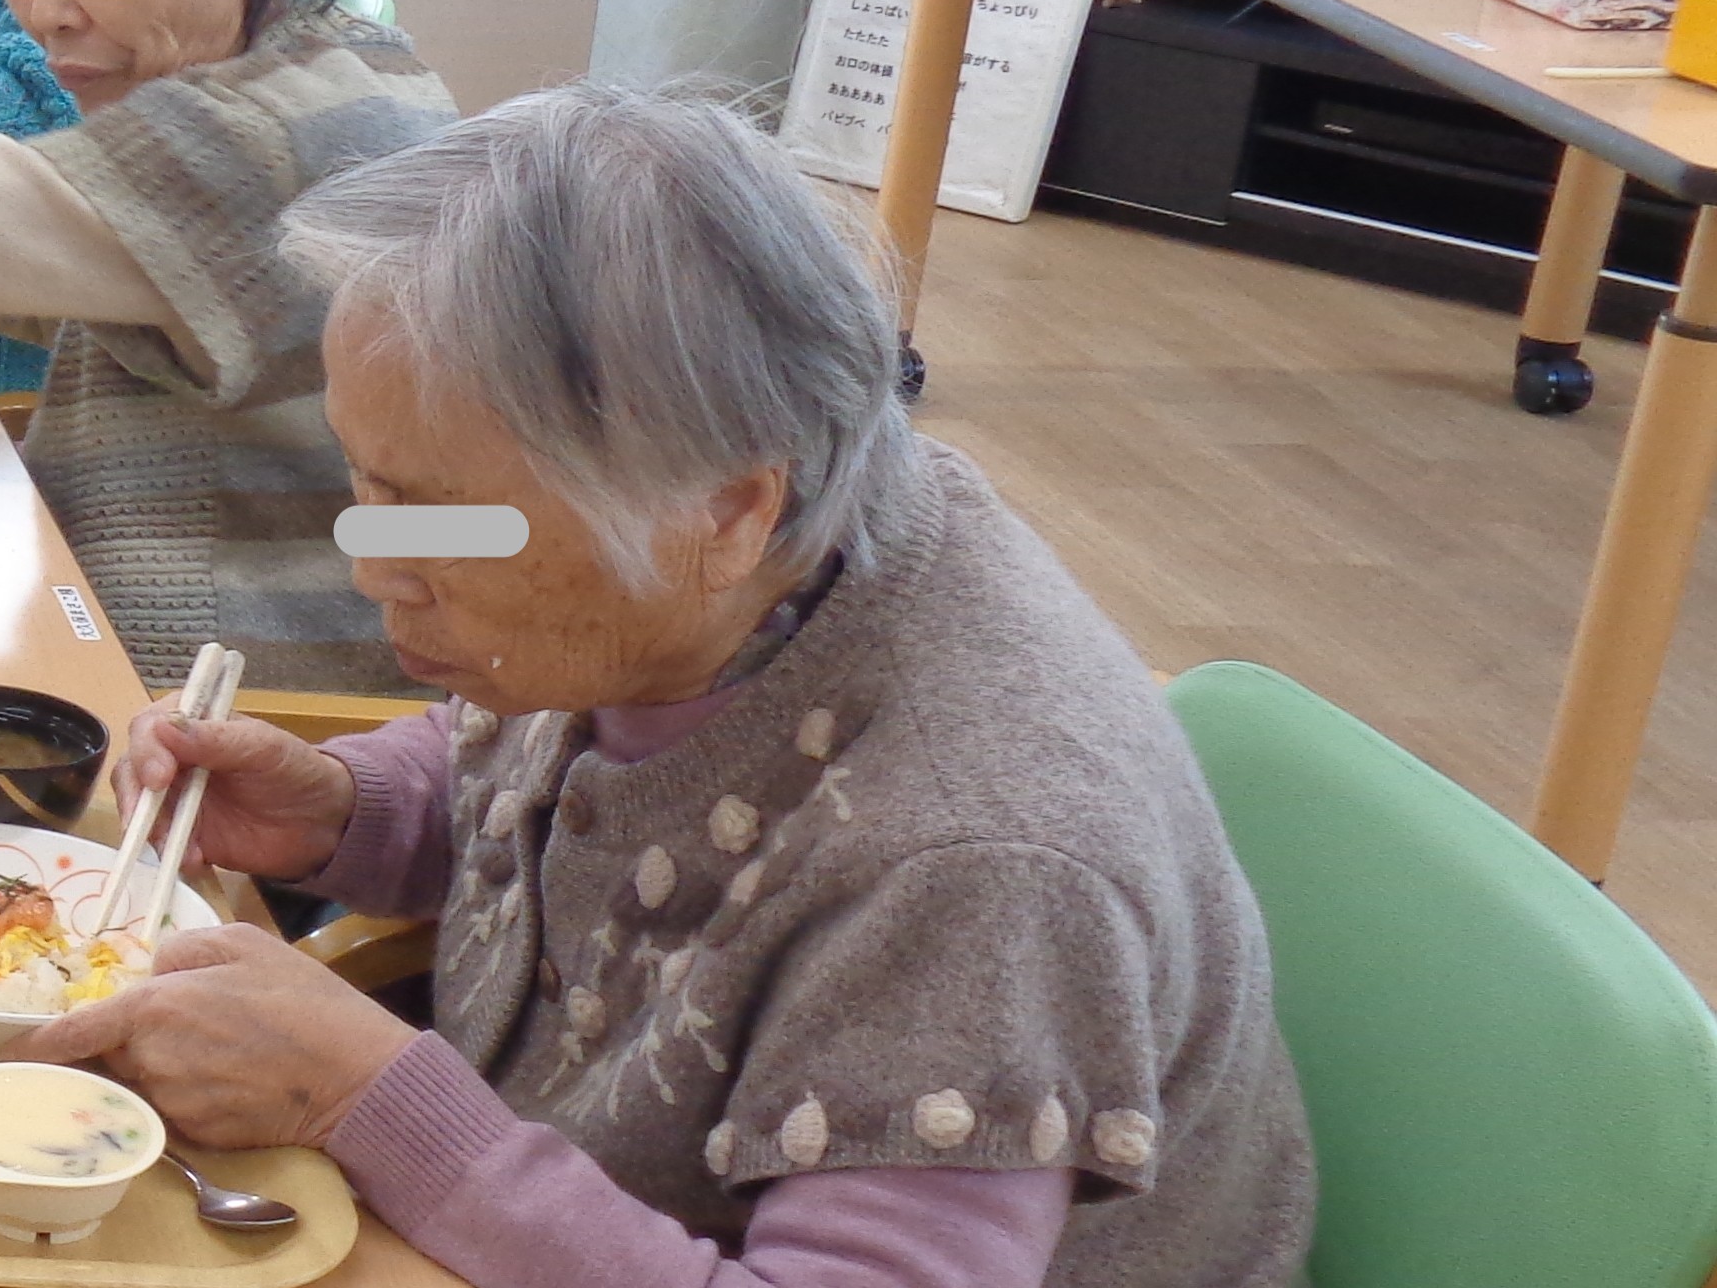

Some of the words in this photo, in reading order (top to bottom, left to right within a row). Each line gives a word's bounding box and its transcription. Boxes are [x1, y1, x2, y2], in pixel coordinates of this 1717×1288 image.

[844, 27, 889, 48] たたたた
[828, 82, 885, 105] あああああ
